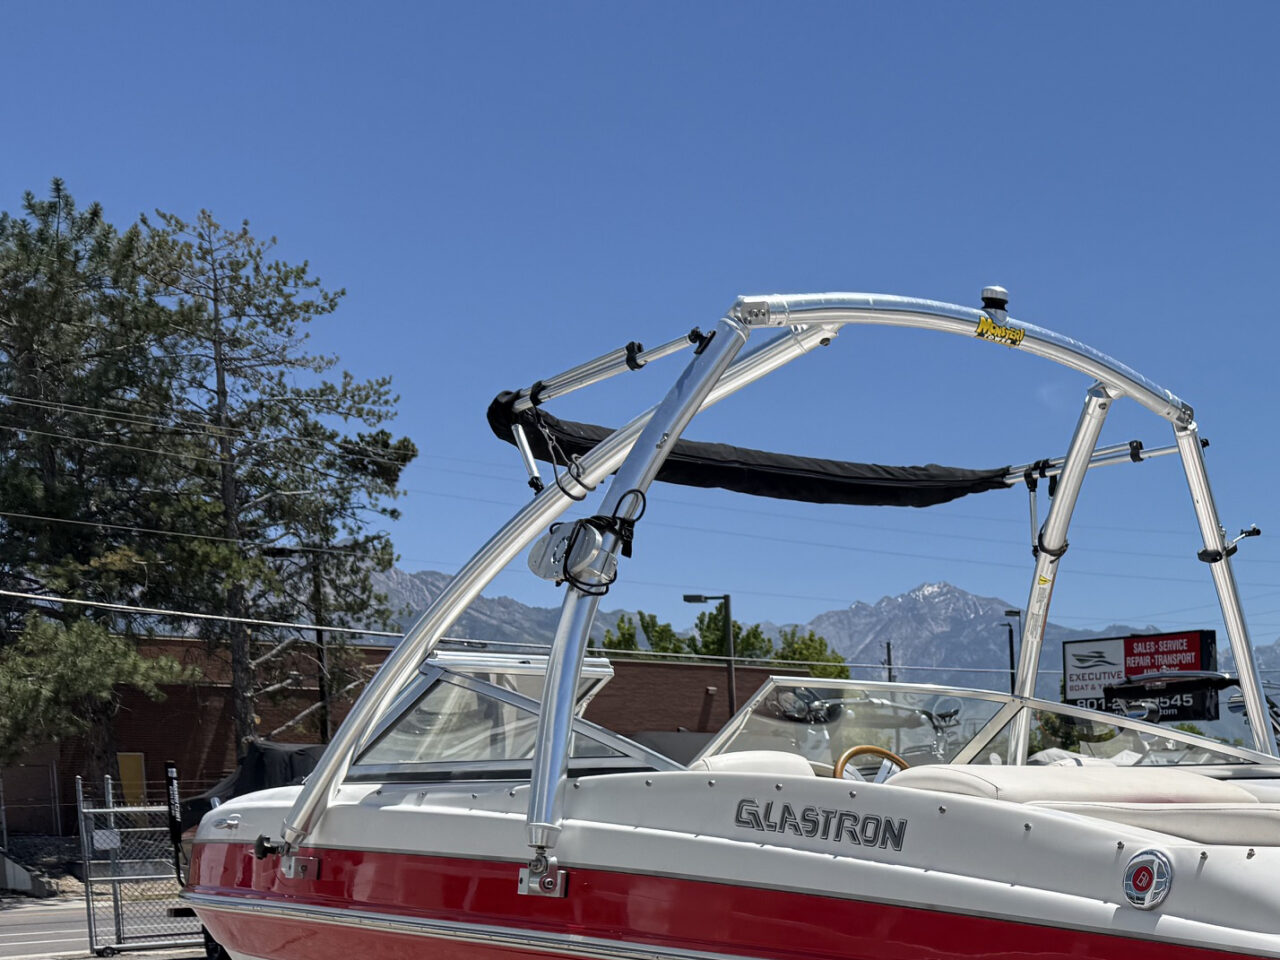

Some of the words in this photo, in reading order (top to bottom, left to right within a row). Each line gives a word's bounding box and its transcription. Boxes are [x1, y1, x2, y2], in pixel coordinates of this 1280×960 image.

[1069, 671, 1123, 682] EXECUTIVE
[1069, 684, 1089, 692] BOAT
[734, 798, 908, 852] GLASTRON
